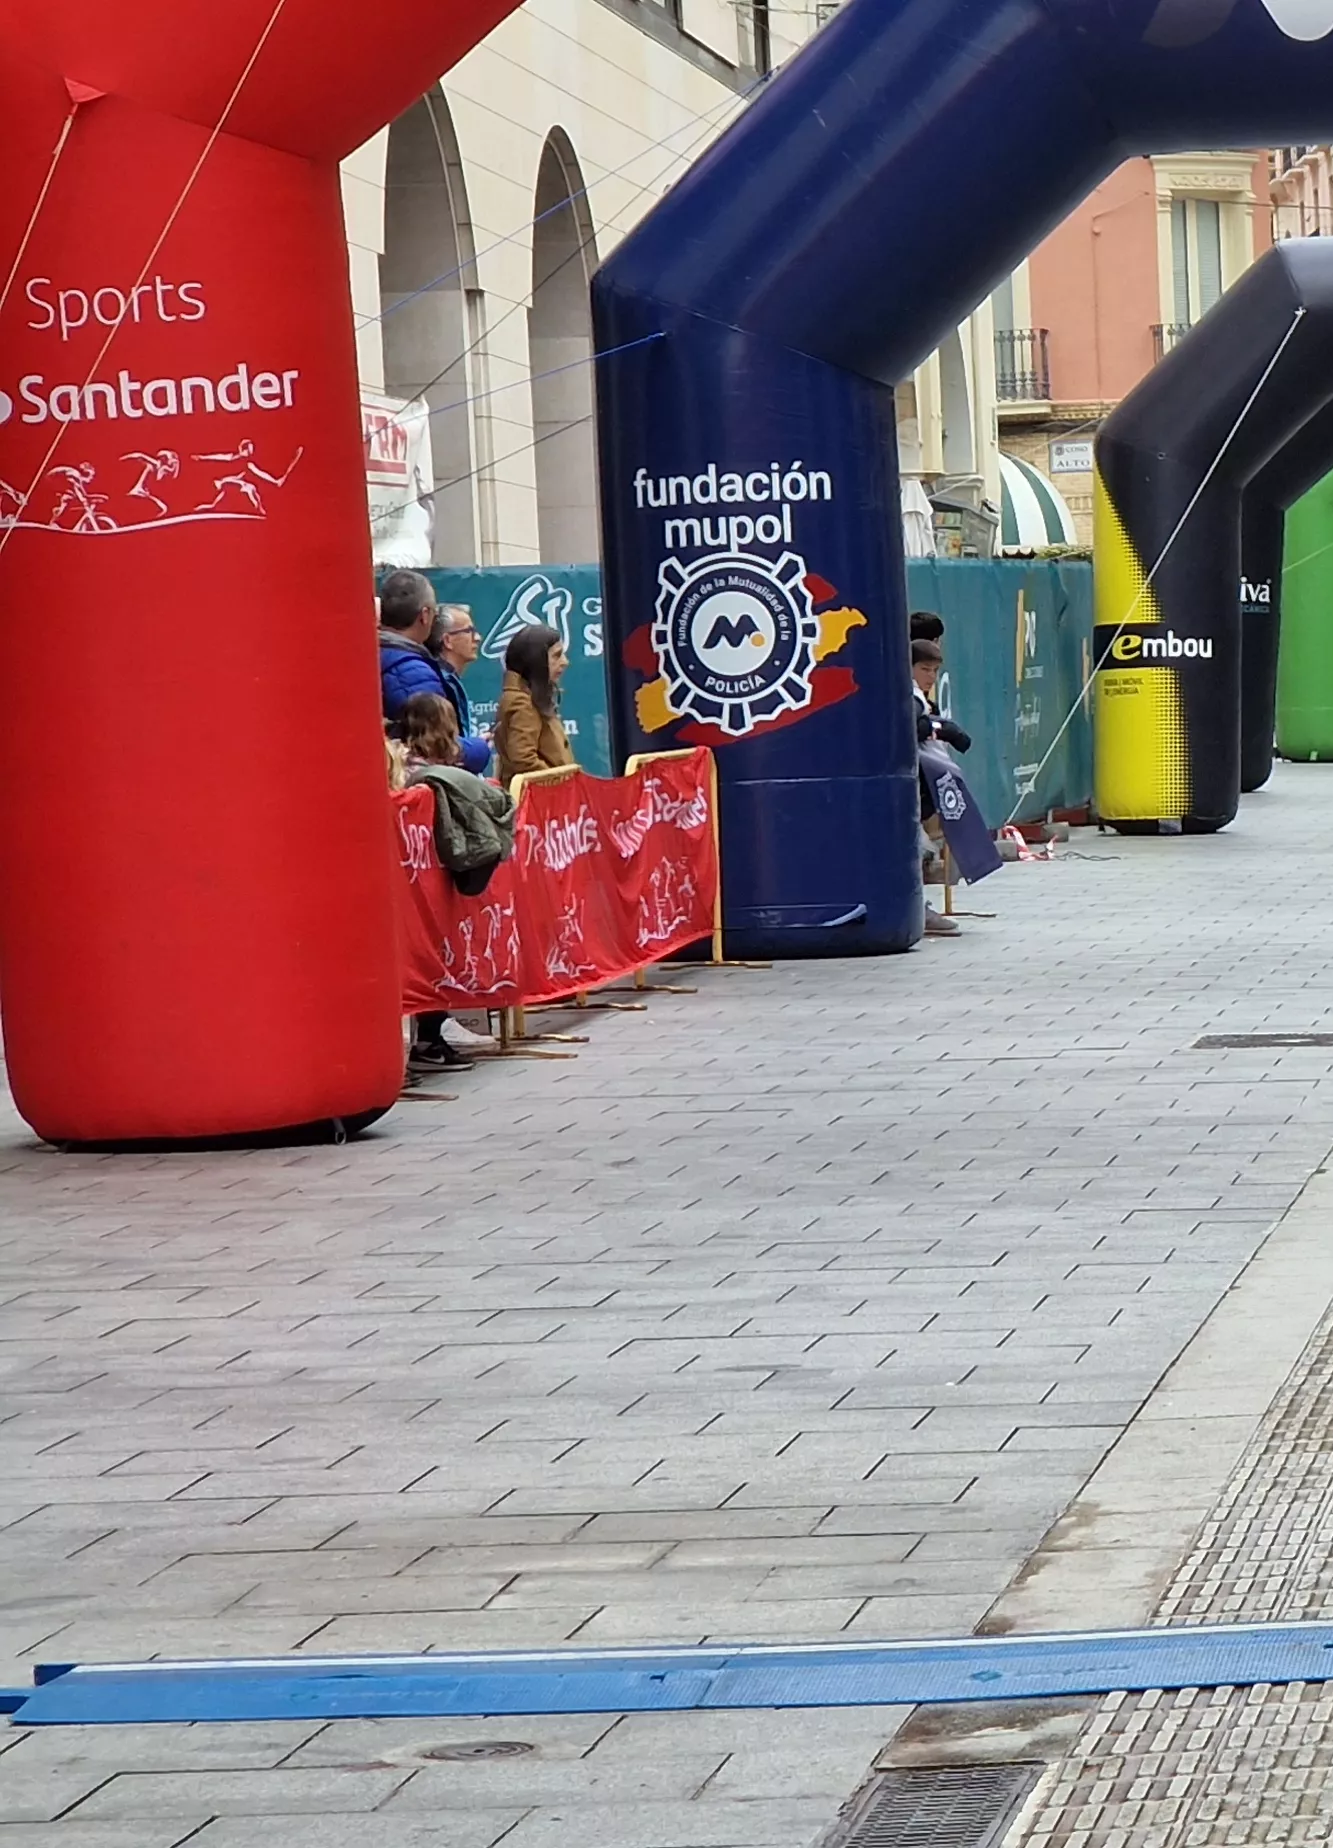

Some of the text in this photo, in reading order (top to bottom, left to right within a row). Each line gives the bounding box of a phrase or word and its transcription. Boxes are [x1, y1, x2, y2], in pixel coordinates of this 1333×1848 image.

[26, 275, 206, 341] Sports
[19, 362, 299, 424] Santander
[633, 461, 833, 509] fundación
[663, 503, 793, 552] mupol
[1111, 629, 1214, 661] embou
[705, 674, 767, 694] POLICÍA
